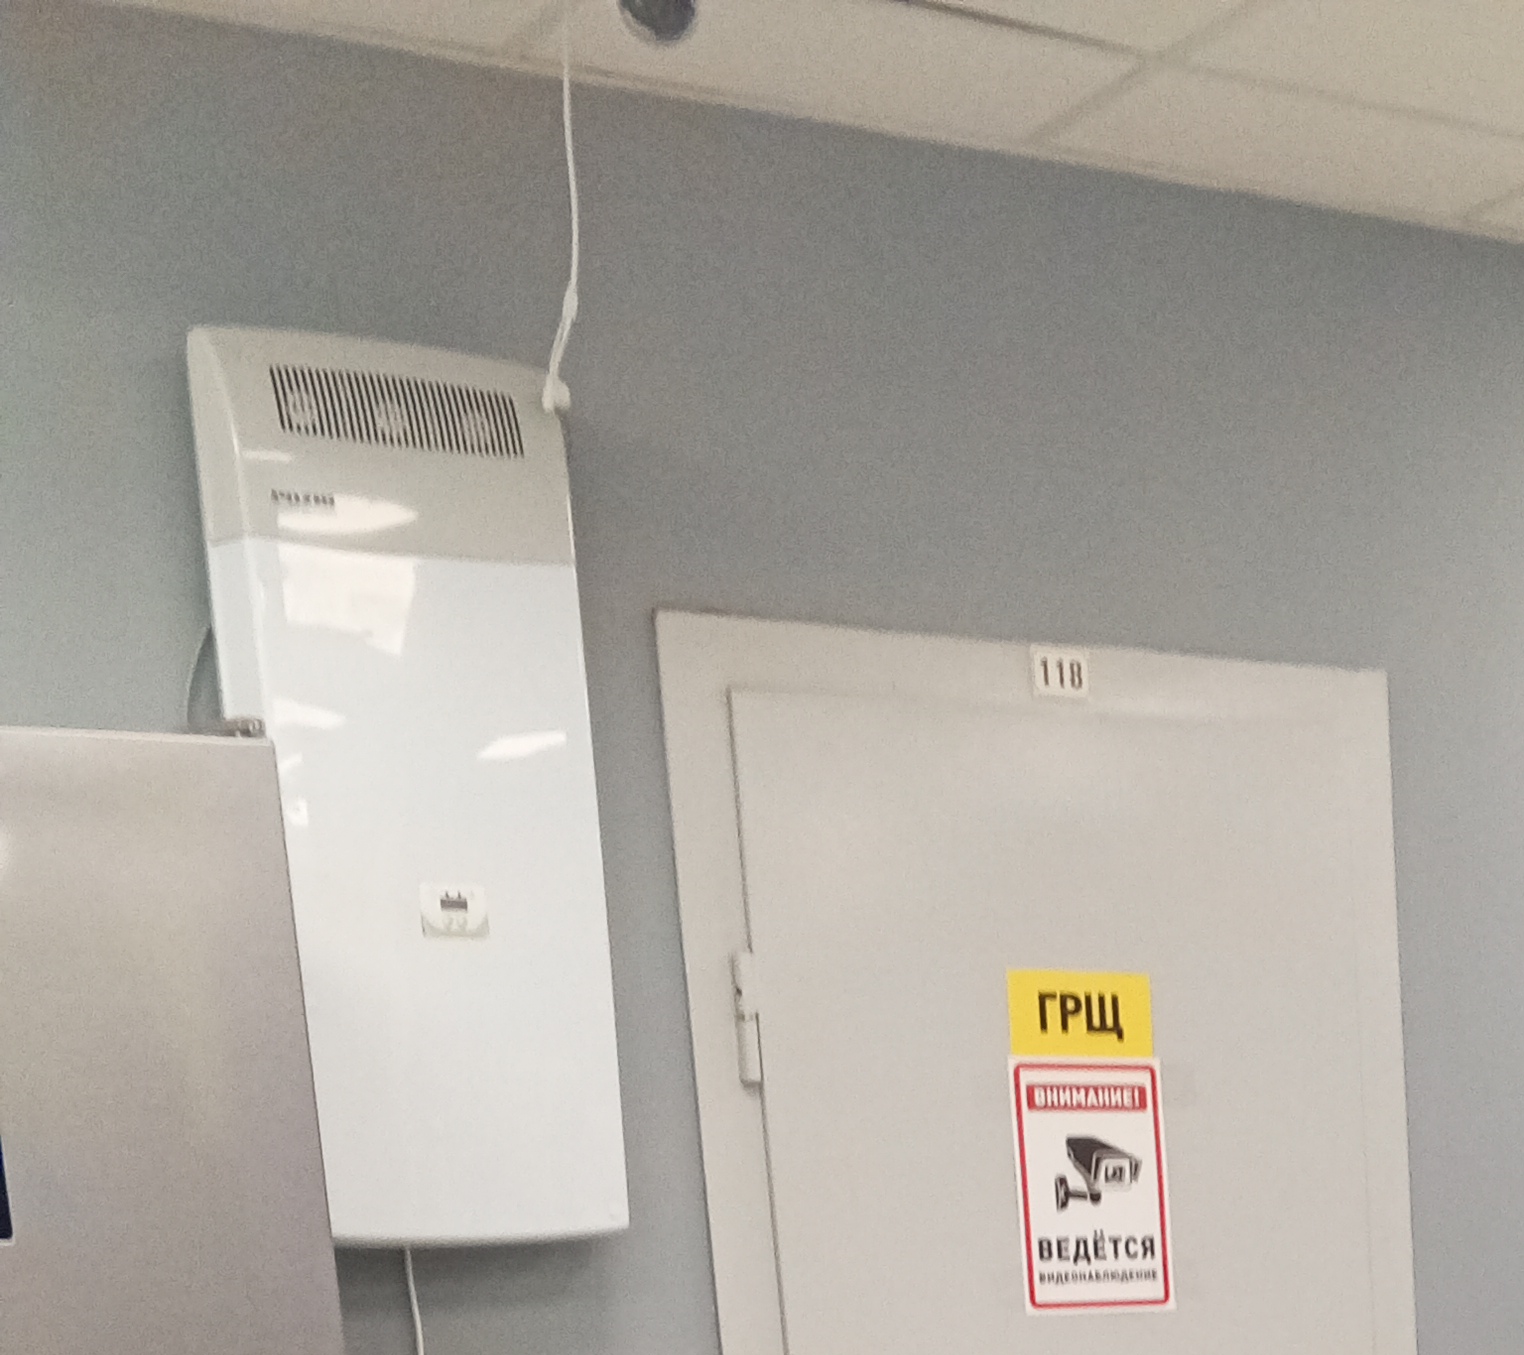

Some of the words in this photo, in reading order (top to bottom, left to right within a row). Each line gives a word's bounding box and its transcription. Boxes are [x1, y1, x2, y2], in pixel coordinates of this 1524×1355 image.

[1041, 656, 1083, 690] 118
[1038, 989, 1124, 1042] ГРЩ
[1034, 1085, 1140, 1108] ВНИМАНИЕ!
[1037, 1228, 1156, 1266] ВЕДЁТСЯ
[1038, 1269, 1158, 1285] ВИДЕОНАБЛЮДЕНИЕ
